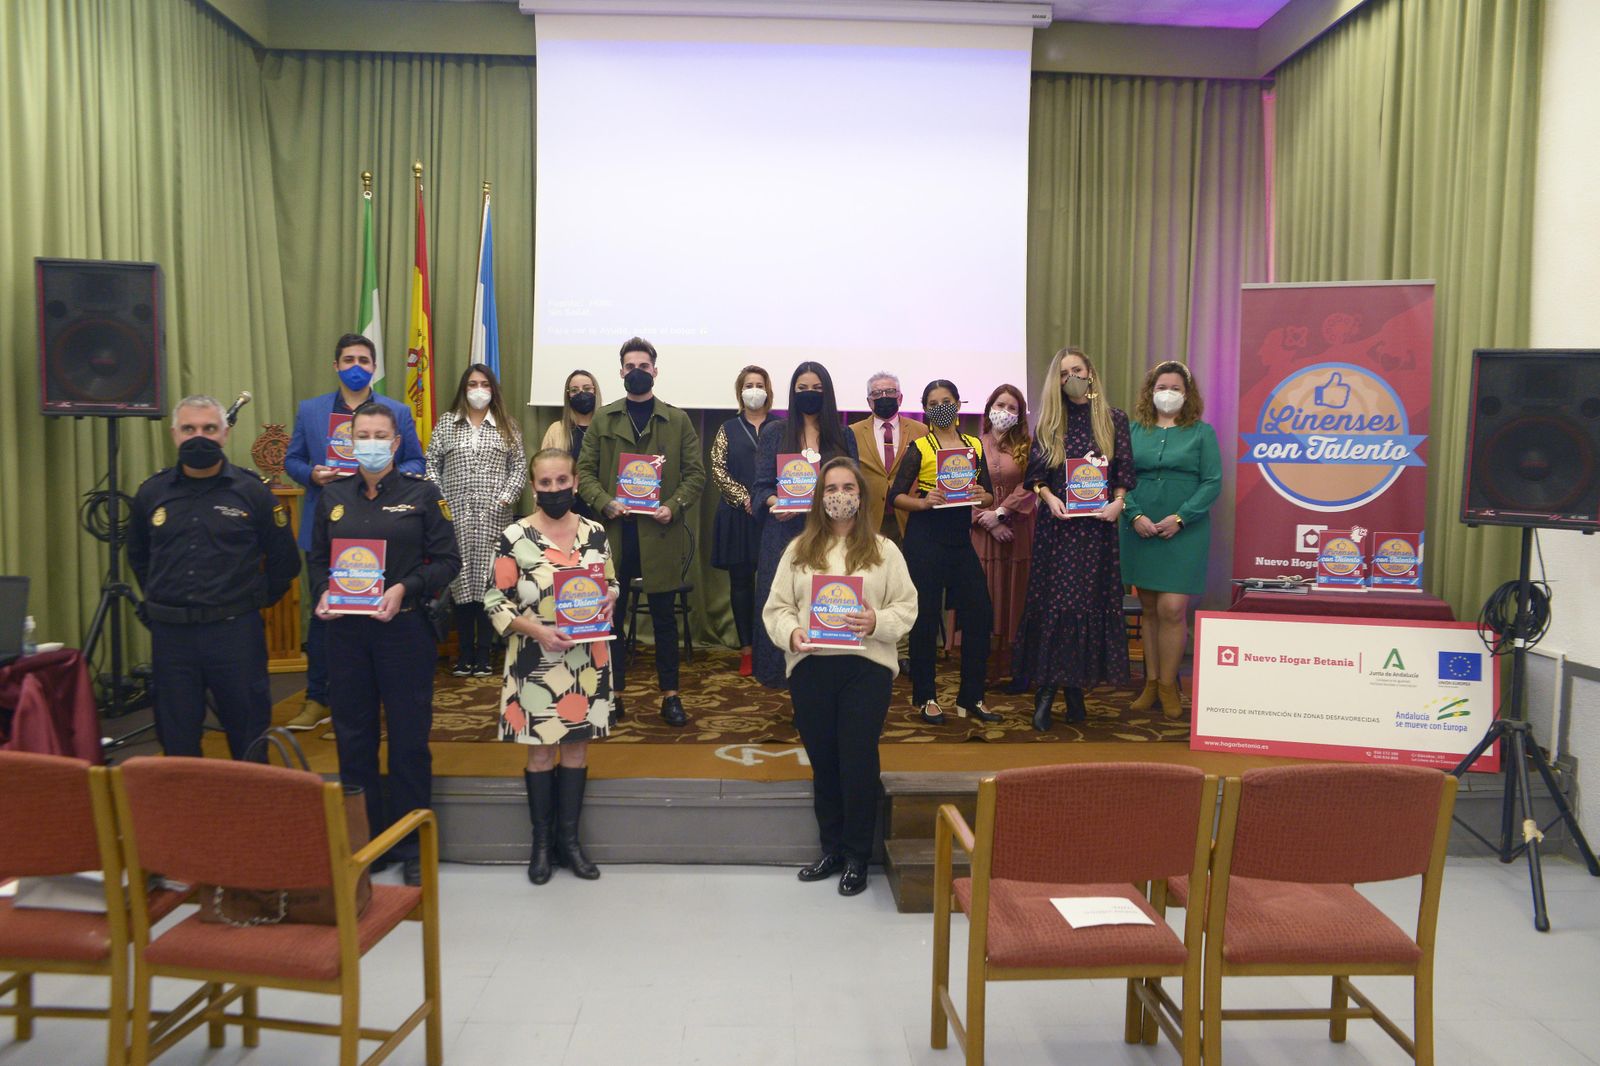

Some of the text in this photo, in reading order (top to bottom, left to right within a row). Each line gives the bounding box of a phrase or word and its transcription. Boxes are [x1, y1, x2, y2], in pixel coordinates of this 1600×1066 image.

[1264, 405, 1400, 435] Linenses
[1253, 435, 1411, 460] con Talento
[1255, 557, 1318, 571] Nuevo Hoga
[574, 596, 599, 608] Talent
[1244, 653, 1354, 667] Nuevo Hogar Betania
[1206, 706, 1237, 714] PROYECTO
[1248, 709, 1292, 718] INTERVENCIÓN
[1325, 714, 1380, 723] DESFAVORECIDAS
[1396, 711, 1430, 721] Andalucía
[1404, 722, 1428, 730] mueve
[1443, 723, 1468, 733] Europa
[1204, 740, 1269, 751] www.hogarbetania.es
